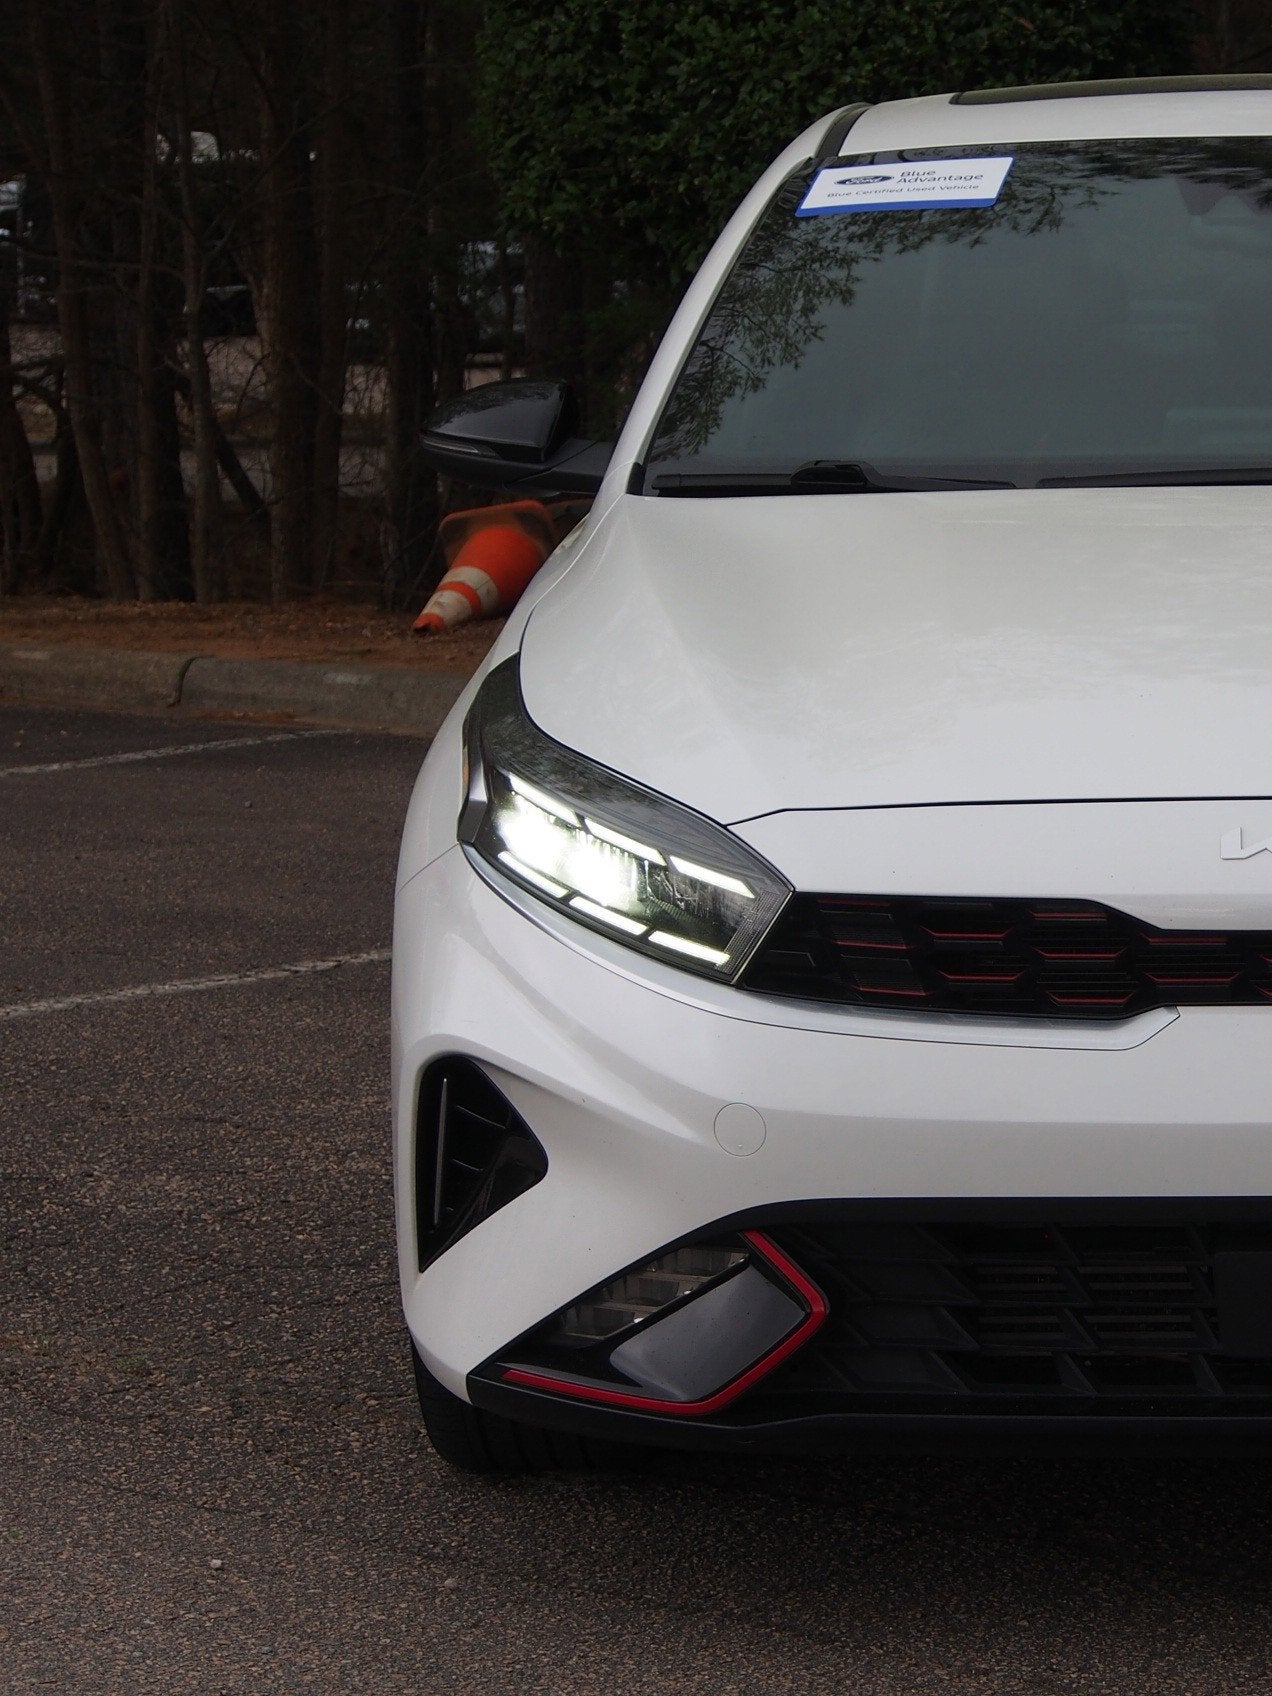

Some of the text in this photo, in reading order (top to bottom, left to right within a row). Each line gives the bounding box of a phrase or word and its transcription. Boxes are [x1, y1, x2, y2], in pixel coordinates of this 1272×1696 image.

[896, 173, 984, 184] Advantage
[855, 187, 904, 196] Certified
[906, 185, 936, 193] Used
